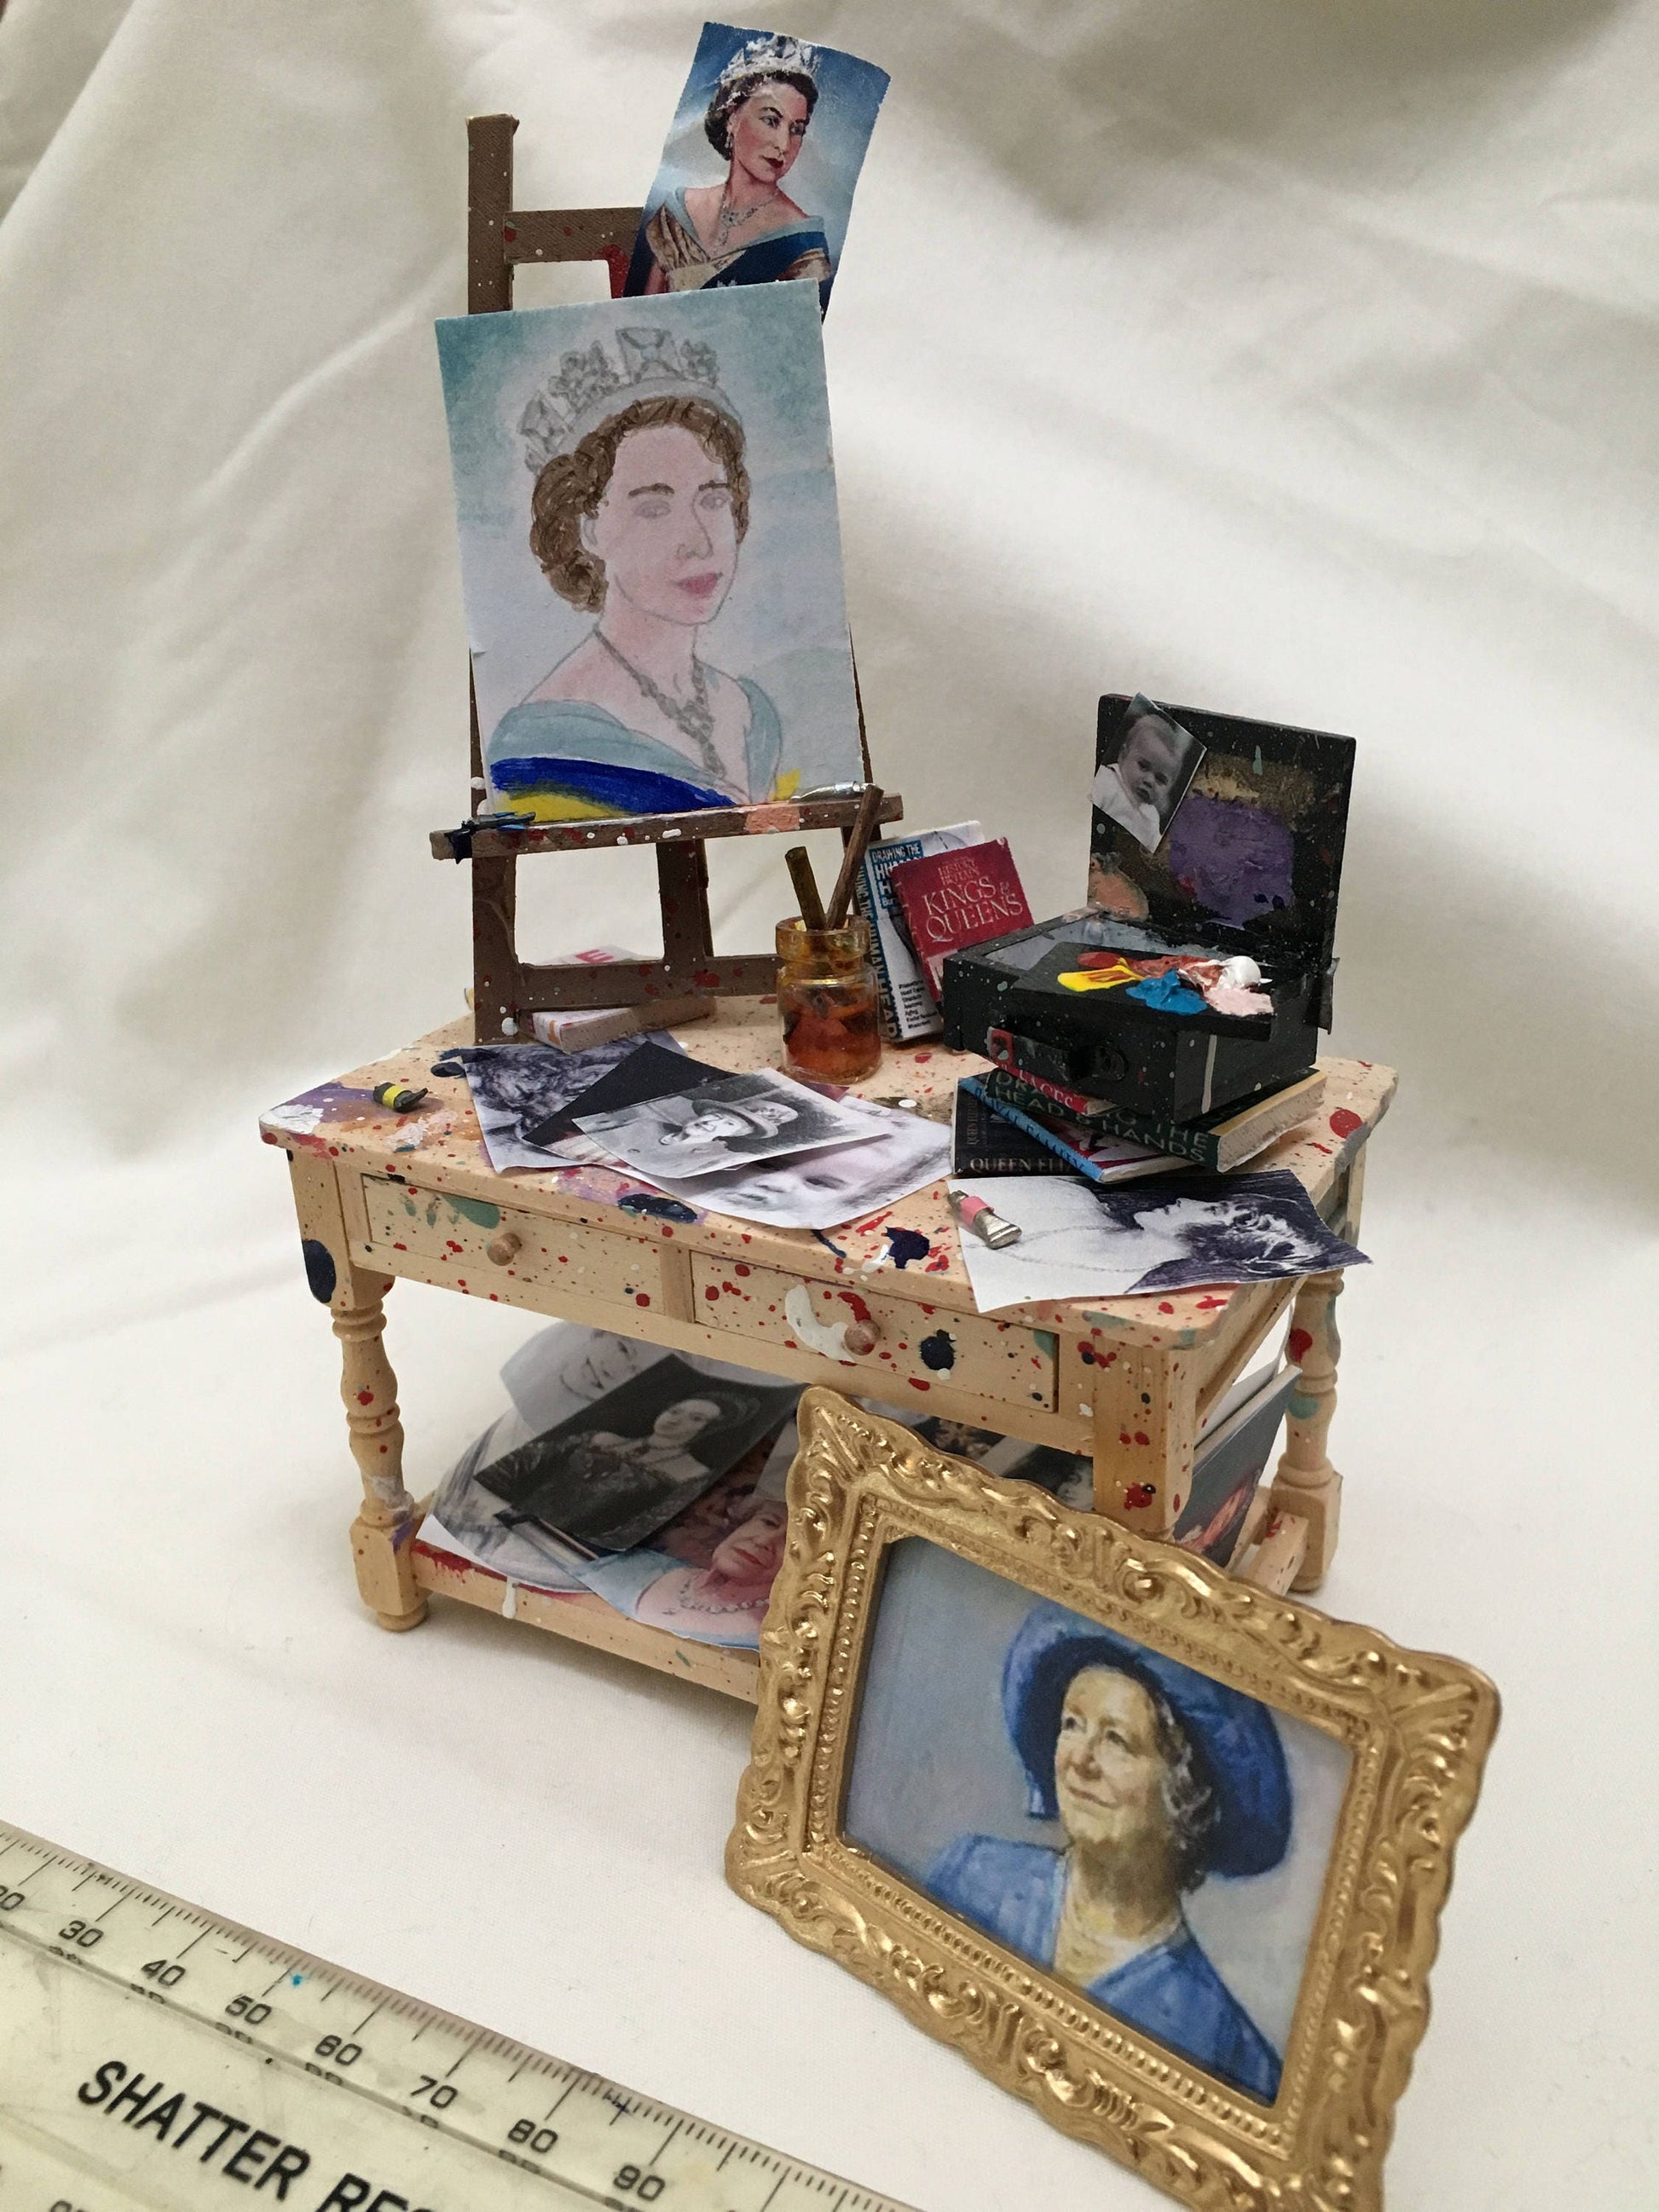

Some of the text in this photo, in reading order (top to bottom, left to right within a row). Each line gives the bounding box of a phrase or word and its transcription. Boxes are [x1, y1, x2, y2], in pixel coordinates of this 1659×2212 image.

[871, 843, 921, 863] DRAWING THE
[922, 876, 996, 915] KINGS
[926, 893, 1023, 943] QUEENS
[878, 979, 899, 1037] HEAD
[995, 1086, 1064, 1117] HEAD
[1102, 1119, 1205, 1162] HANDS
[970, 1158, 1032, 1174] QUEEN
[59, 1920, 104, 1948] 30
[141, 1960, 186, 1987] 40
[225, 1995, 272, 2024] 50
[315, 2035, 362, 2065] 60
[410, 2075, 458, 2109] 70
[507, 2118, 558, 2153] 80
[612, 2164, 665, 2201] 90
[78, 2060, 310, 2202] SHATTER
